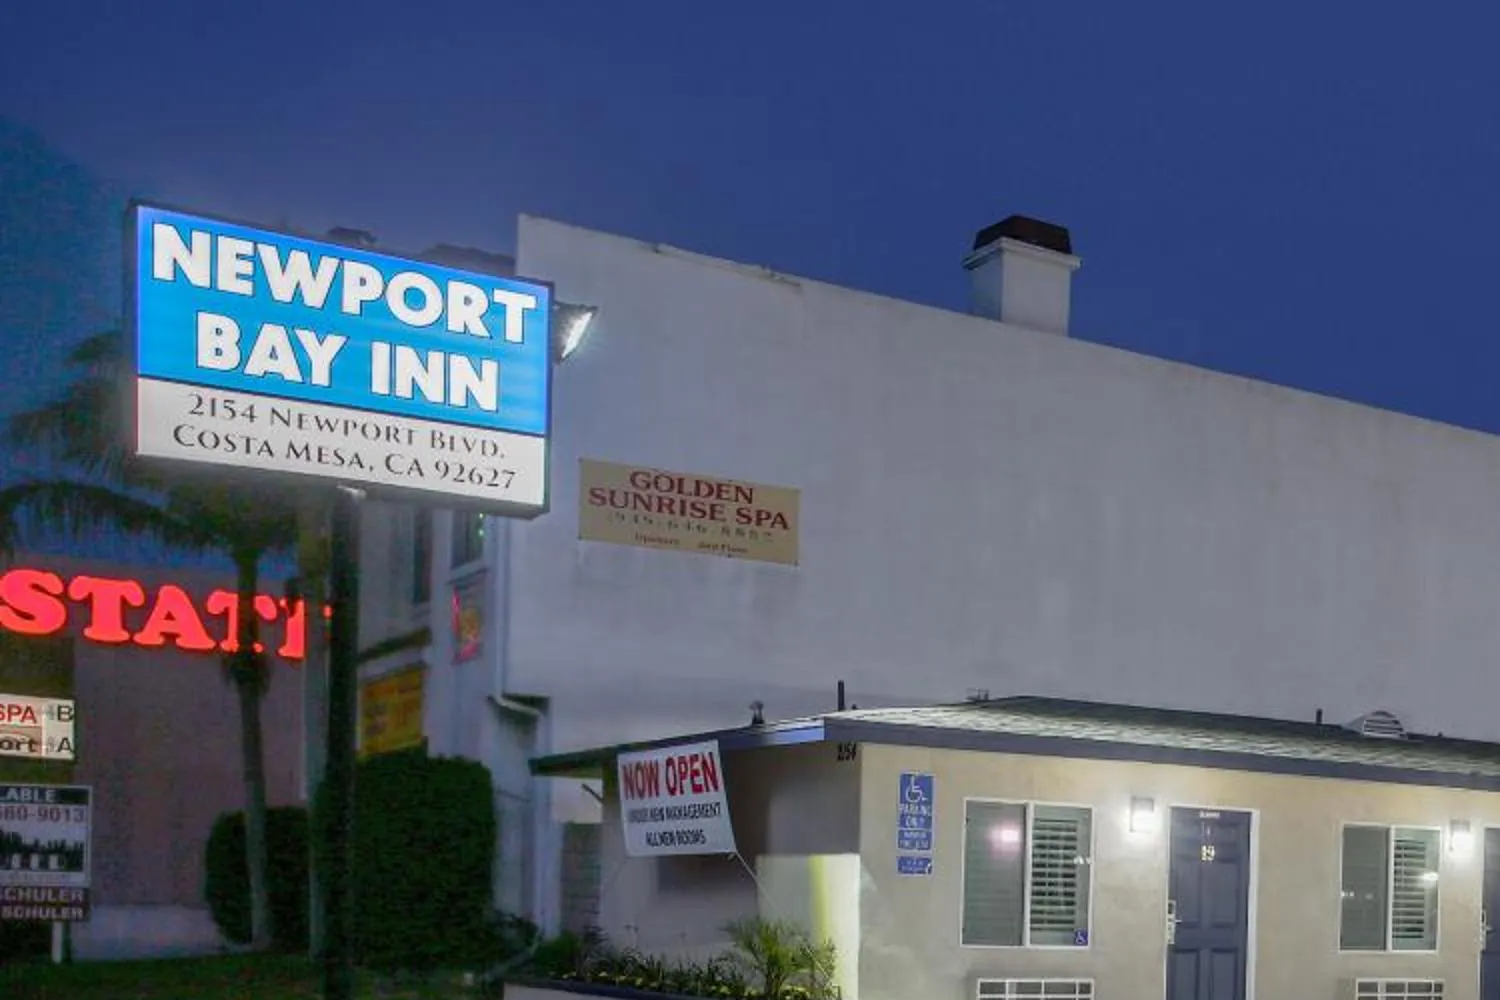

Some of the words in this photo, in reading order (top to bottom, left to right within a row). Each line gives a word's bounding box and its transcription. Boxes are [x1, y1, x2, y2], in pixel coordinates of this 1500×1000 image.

[152, 223, 537, 344] NEWPORT
[196, 311, 349, 387] BAY
[371, 341, 499, 412] INN
[188, 393, 257, 423] 2154
[269, 407, 418, 446] NEWPORT
[430, 430, 505, 459] BLVD.
[173, 424, 275, 457] COSTA
[285, 438, 374, 472] MESA,
[385, 454, 424, 478] CA
[434, 462, 517, 489] 92627
[589, 487, 726, 522] SUNRISE
[735, 507, 790, 530] SPA
[629, 470, 753, 504] GOLDEN
[623, 759, 660, 800] NOW
[666, 752, 719, 796] OPEN
[0, 887, 84, 902] CHULER
